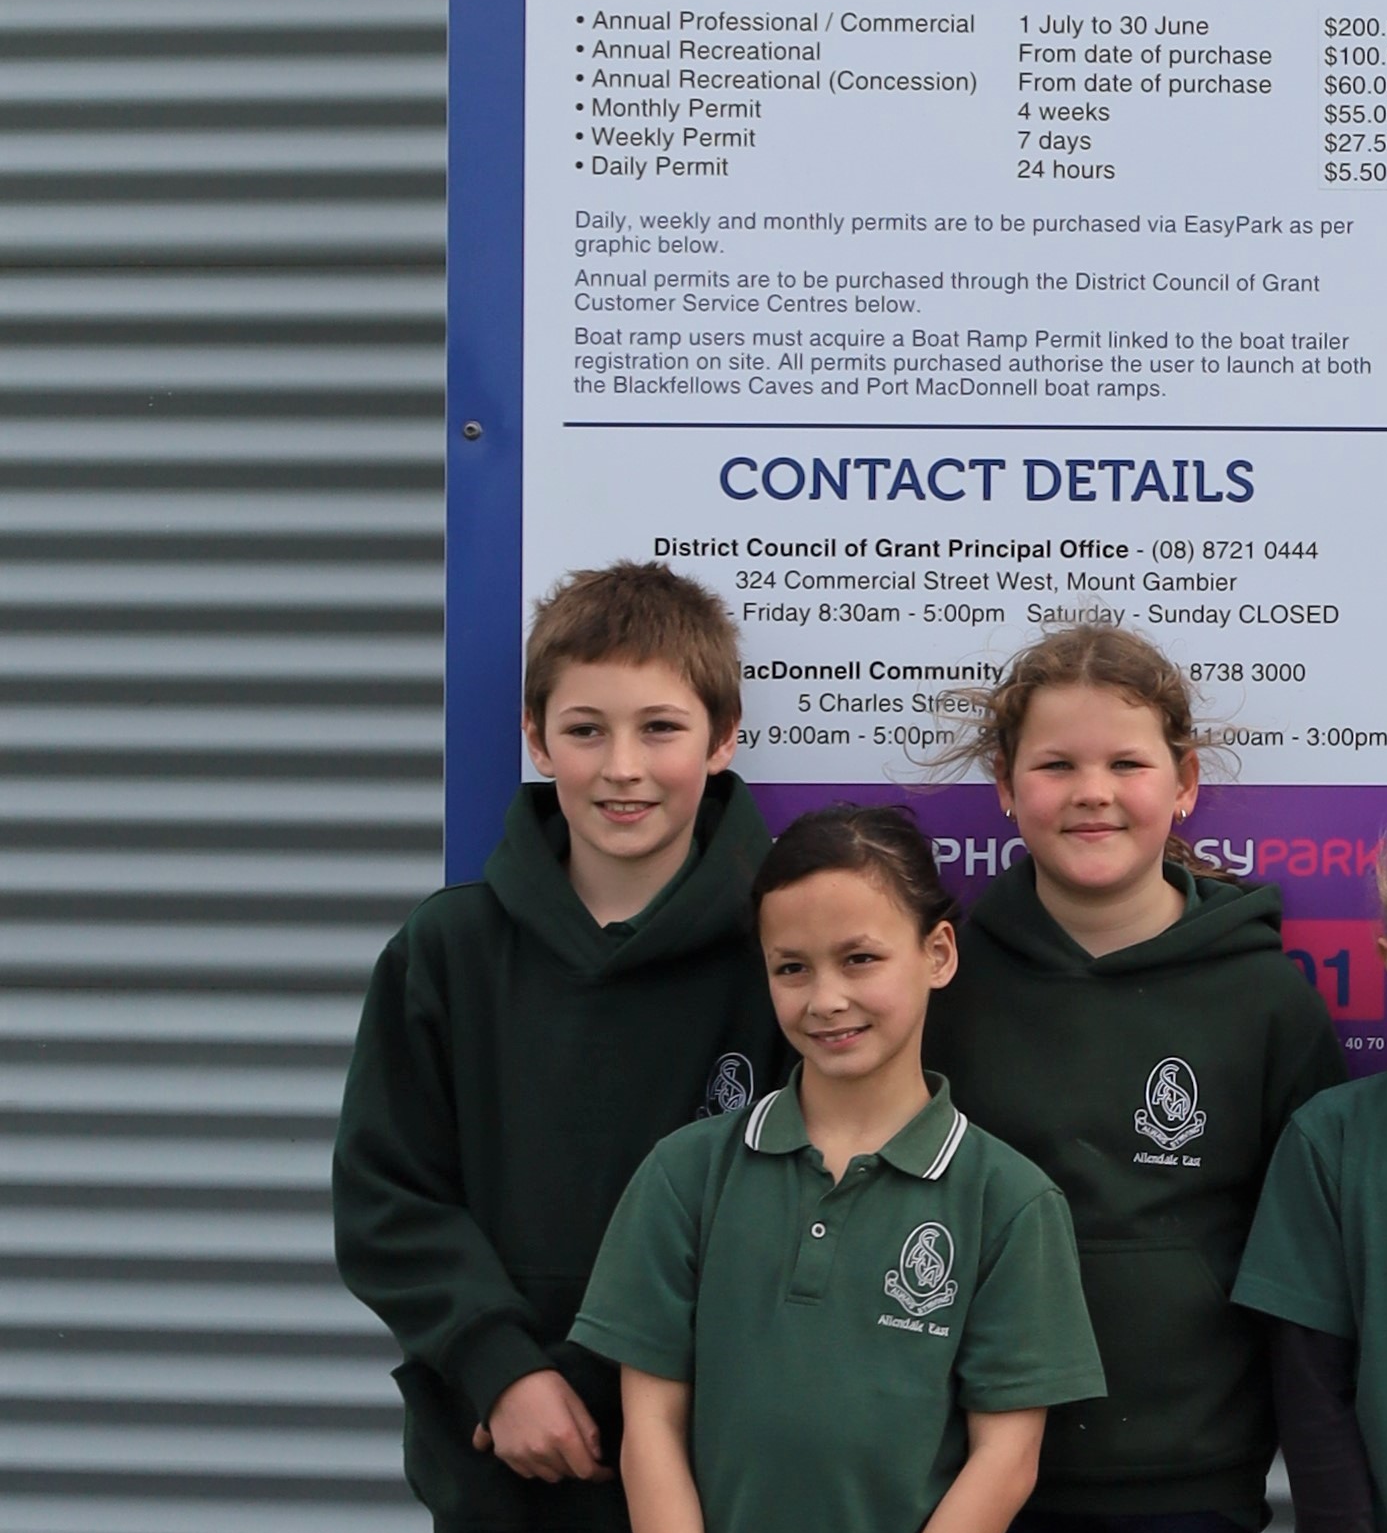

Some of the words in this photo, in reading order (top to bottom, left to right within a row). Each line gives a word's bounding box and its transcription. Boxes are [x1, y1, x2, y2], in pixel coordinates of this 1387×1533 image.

[593, 11, 670, 30] Annual
[680, 11, 817, 31] Professional
[841, 13, 974, 33] Commercial
[1021, 16, 1027, 33] 1
[1039, 15, 1083, 38] July
[1092, 17, 1111, 34] to
[1120, 16, 1147, 34] 30
[1155, 16, 1208, 35] June
[592, 40, 670, 59] Annual
[680, 40, 820, 60] Recreational
[1020, 44, 1075, 62] From
[1085, 44, 1132, 63] date
[1141, 45, 1161, 63] of
[1170, 46, 1271, 68] purchase
[592, 69, 669, 88] Annual
[680, 70, 819, 89] Recreational
[830, 71, 976, 95] (Concession)
[1020, 73, 1075, 91] From
[1085, 73, 1132, 92] date
[1141, 74, 1161, 92] of
[1170, 75, 1271, 97] purchase
[593, 98, 680, 122] Monthly
[690, 99, 761, 118] Permit
[1018, 102, 1031, 120] 4
[1039, 102, 1109, 121] weeks
[592, 127, 674, 151] Weekly
[684, 128, 755, 147] Permit
[1018, 131, 1031, 149] 7
[1039, 131, 1091, 154] days
[593, 156, 647, 180] Daily
[657, 157, 728, 175] Permit
[1018, 160, 1044, 178] 24
[1054, 160, 1115, 179] hours
[1325, 162, 1386, 182] $5.50
[576, 211, 631, 233] Daily,
[640, 212, 710, 233] weekly
[718, 212, 755, 229] and
[764, 213, 844, 234] monthly
[852, 215, 926, 234] permits
[935, 218, 967, 231] are
[975, 215, 993, 231] to
[1001, 214, 1025, 231] be
[1034, 215, 1140, 236] purchased
[1148, 215, 1176, 233] via
[1185, 215, 1282, 237] EasyPark
[1290, 221, 1313, 234] as
[1321, 221, 1353, 238] per
[575, 235, 650, 257] graphic
[659, 236, 723, 253] below.
[575, 293, 675, 311] Customer
[683, 294, 759, 312] Service
[767, 294, 847, 312] Centres
[856, 296, 920, 313] below.
[574, 376, 605, 393] the
[614, 376, 740, 394] Blackfellows
[749, 377, 813, 394] Caves
[821, 378, 858, 395] and
[868, 378, 908, 395] Port
[916, 378, 1037, 396] MacDonnell
[1045, 379, 1089, 396] boat
[1098, 383, 1165, 400] ramps.
[720, 457, 1005, 501] CONTACT
[1023, 459, 1254, 503] DETAILS
[655, 538, 738, 556] District
[747, 538, 835, 557] Council
[845, 539, 867, 557] of
[876, 539, 940, 557] Grant
[949, 539, 1050, 562] Principal
[1060, 540, 1128, 558] Office
[1153, 541, 1193, 562] (08)
[1203, 541, 1252, 559] 8721
[1265, 542, 1318, 559] 0444
[736, 571, 776, 589] 324
[785, 570, 915, 589] Commercial
[924, 571, 989, 590] Street
[997, 572, 1057, 593] West,
[1068, 572, 1135, 590] Mount
[1143, 572, 1237, 591] Gambier
[743, 603, 810, 627] Friday
[819, 603, 900, 623] 8:30am
[924, 604, 1005, 627] 5:00pm
[1027, 605, 1126, 629] Saturday
[1148, 605, 1232, 629] Sunday
[1239, 605, 1340, 625] CLOSED
[738, 662, 861, 680] acDonnell
[870, 661, 1004, 685] Community
[1190, 663, 1243, 681] 8738
[1252, 663, 1305, 681] 3000
[799, 694, 810, 712] 5
[819, 693, 903, 713] Charles
[769, 726, 849, 744] 9:00am
[874, 727, 954, 746] 5:00pm
[1307, 728, 1387, 750] 3:00pm
[1345, 1037, 1363, 1050] 40
[1367, 1037, 1385, 1050] 70
